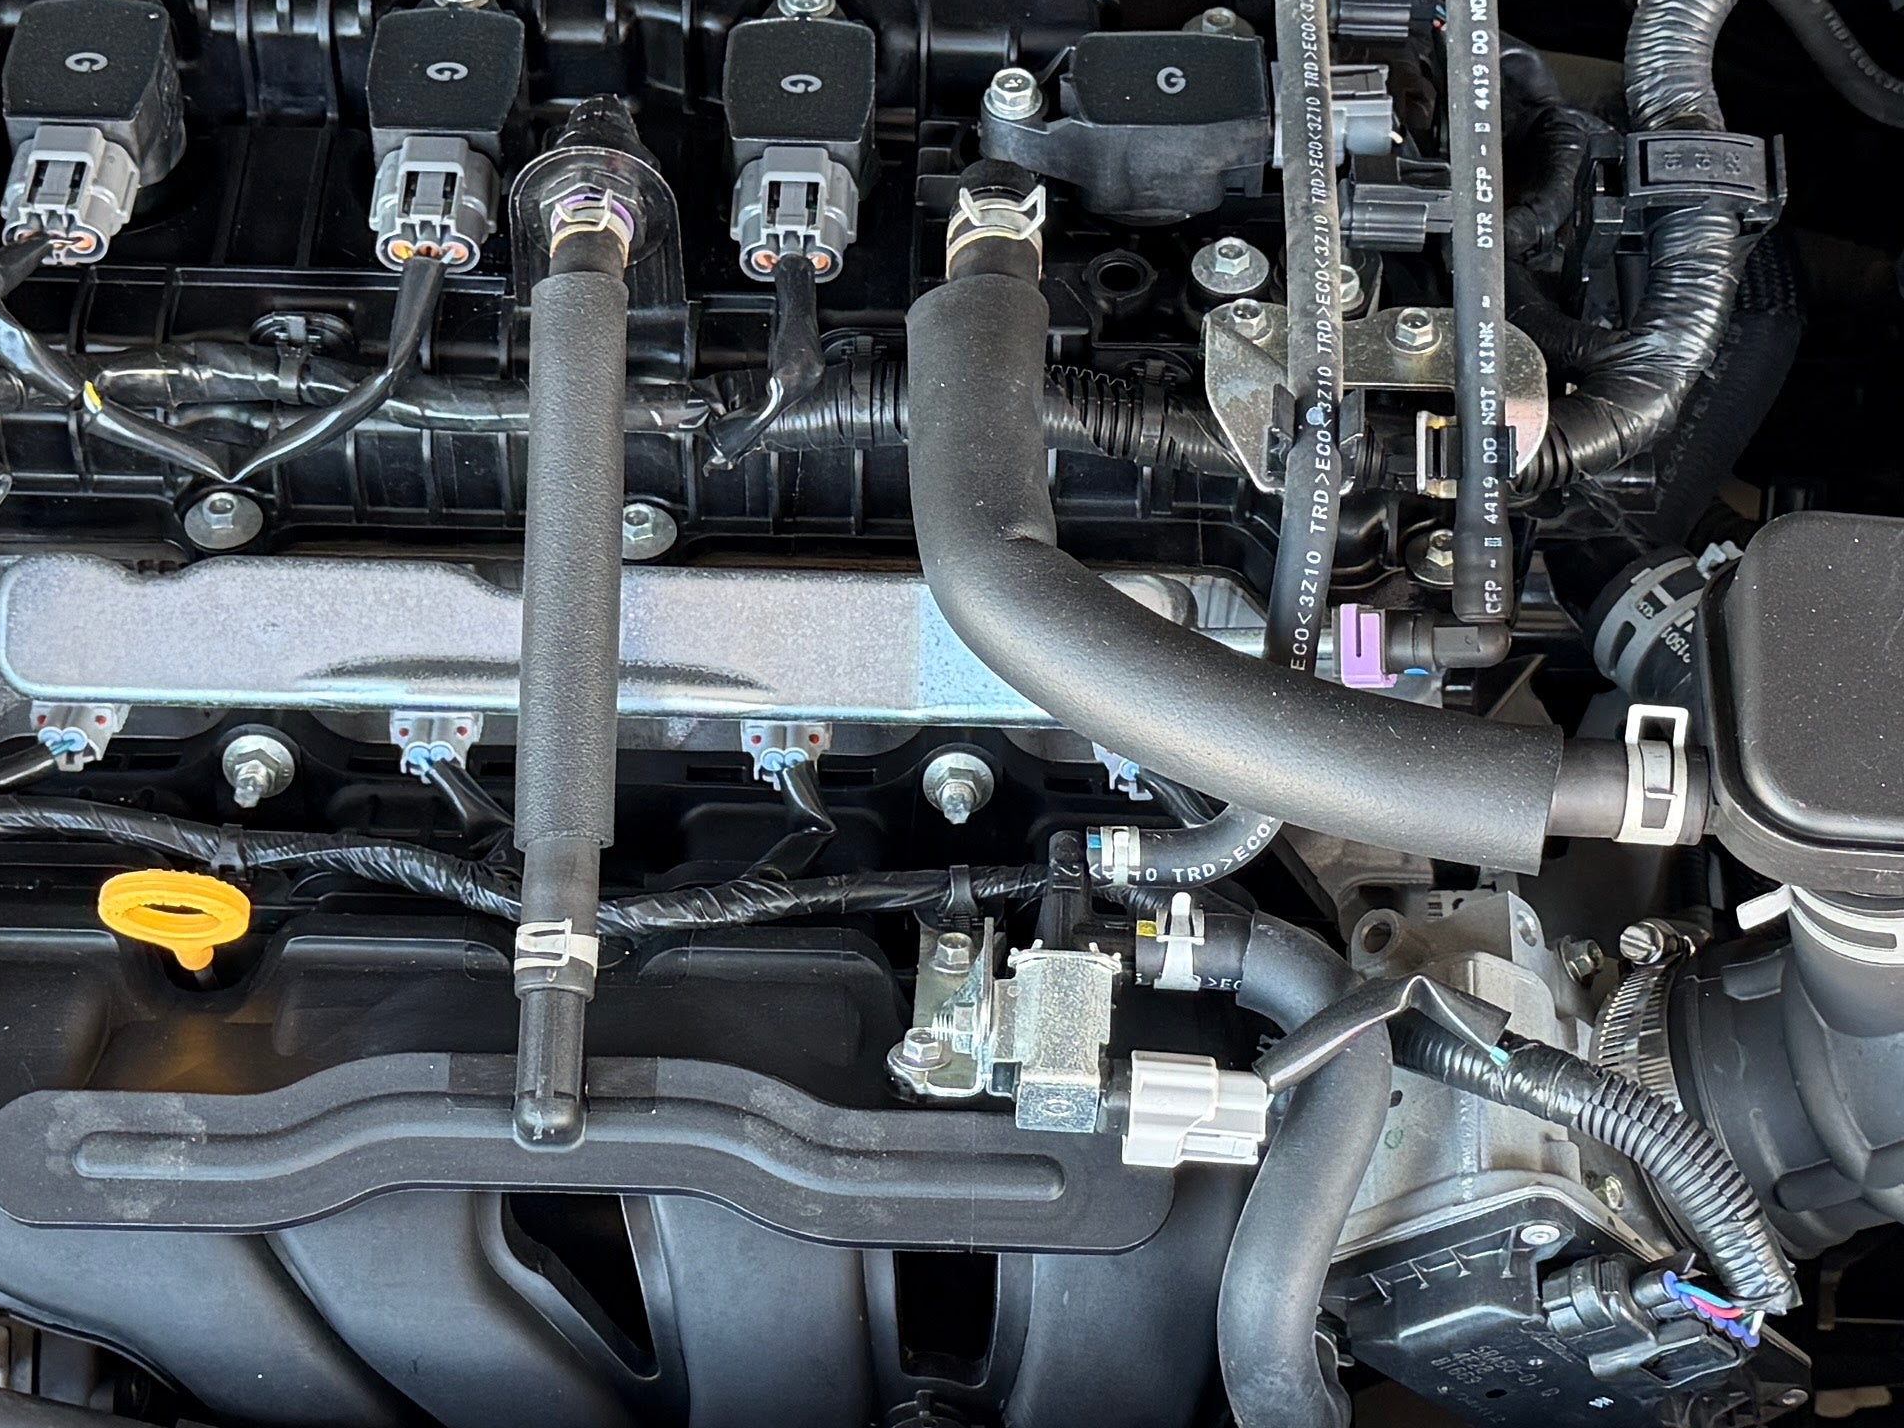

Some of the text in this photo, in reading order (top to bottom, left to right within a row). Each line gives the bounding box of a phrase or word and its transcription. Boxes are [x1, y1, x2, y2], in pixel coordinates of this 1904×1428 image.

[65, 51, 109, 73] G
[426, 61, 469, 82] G
[780, 73, 823, 94] G
[1155, 66, 1187, 94] G
[1478, 321, 1496, 374] KINK
[1479, 385, 1498, 426] NOT
